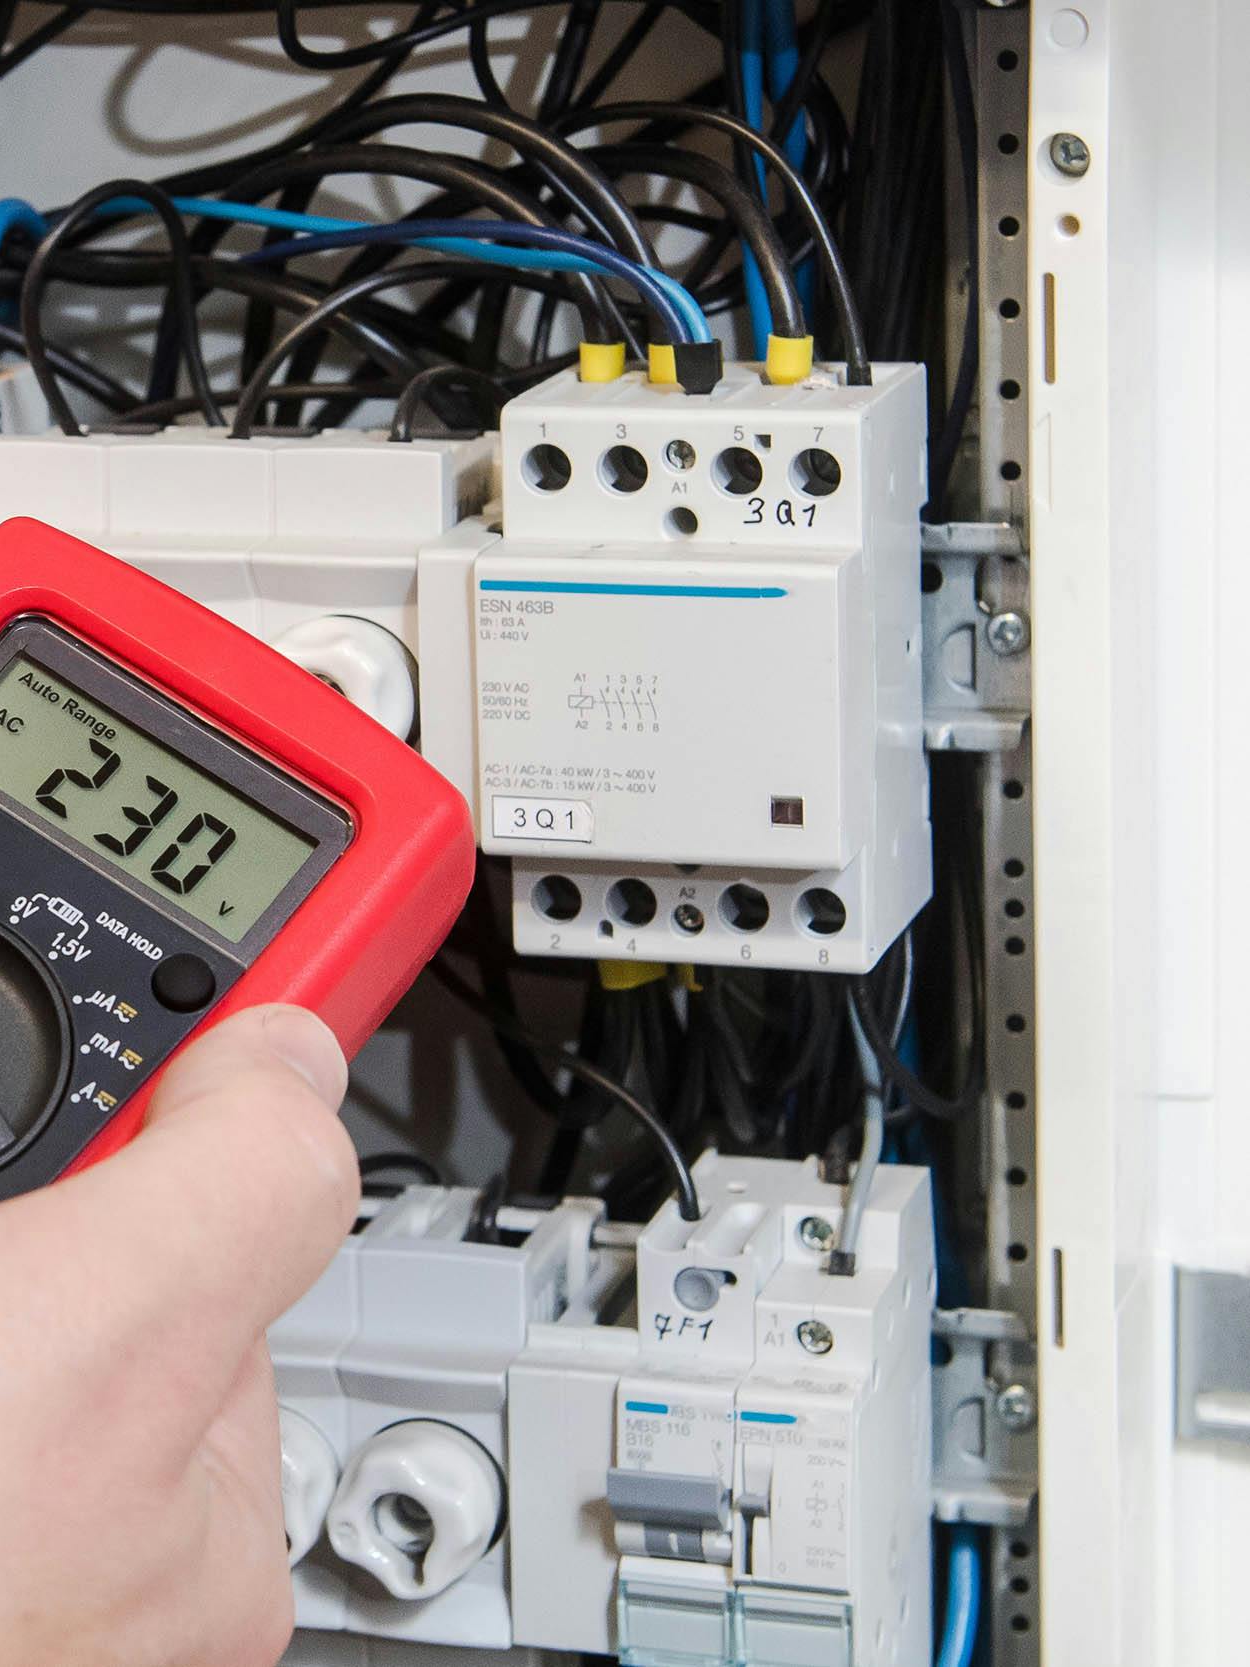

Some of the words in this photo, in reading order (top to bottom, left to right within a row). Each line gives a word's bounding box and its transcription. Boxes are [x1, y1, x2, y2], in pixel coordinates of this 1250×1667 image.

[539, 423, 547, 437] 1
[616, 423, 627, 439] 3
[734, 425, 745, 441] 5
[813, 427, 824, 442] 7
[671, 481, 688, 494] A1
[480, 599, 512, 613] ESN
[516, 600, 555, 615] 463B
[501, 617, 515, 627] 63
[517, 618, 526, 627] A
[500, 631, 520, 641] 440
[521, 631, 530, 641] V
[573, 673, 587, 683] A1
[620, 675, 627, 684] 3
[482, 681, 502, 692] 230
[504, 682, 511, 692] V
[18, 671, 61, 703] Auto
[61, 699, 118, 741] Range
[482, 709, 502, 720] 220
[504, 709, 512, 720] V
[514, 710, 531, 720] DC
[575, 720, 588, 730] A2
[606, 721, 612, 731] 2
[621, 722, 628, 731] 4
[484, 764, 510, 774] AC-1
[561, 766, 575, 776] 40
[577, 767, 594, 777] kW
[602, 769, 610, 779] 3
[626, 769, 646, 780] 400
[647, 770, 656, 780] V
[485, 777, 511, 788] AC-3
[520, 779, 554, 789] AC-7b
[563, 780, 575, 790] 15
[578, 781, 595, 791] kW
[604, 783, 611, 793] 3
[626, 783, 647, 793] 400
[648, 784, 657, 793] V
[35, 738, 237, 895] 230
[678, 886, 697, 900] A2
[10, 895, 41, 919] 9V
[95, 911, 129, 942] DATA
[123, 931, 164, 961] HOLD
[550, 933, 561, 950] 2
[51, 931, 91, 963] 1.5V
[626, 938, 637, 955] 4
[740, 944, 752, 960] 6
[818, 948, 830, 965] 8
[89, 1031, 122, 1059] mA
[78, 1081, 97, 1099] A
[764, 1331, 785, 1347] A1
[625, 1432, 654, 1448] B16
